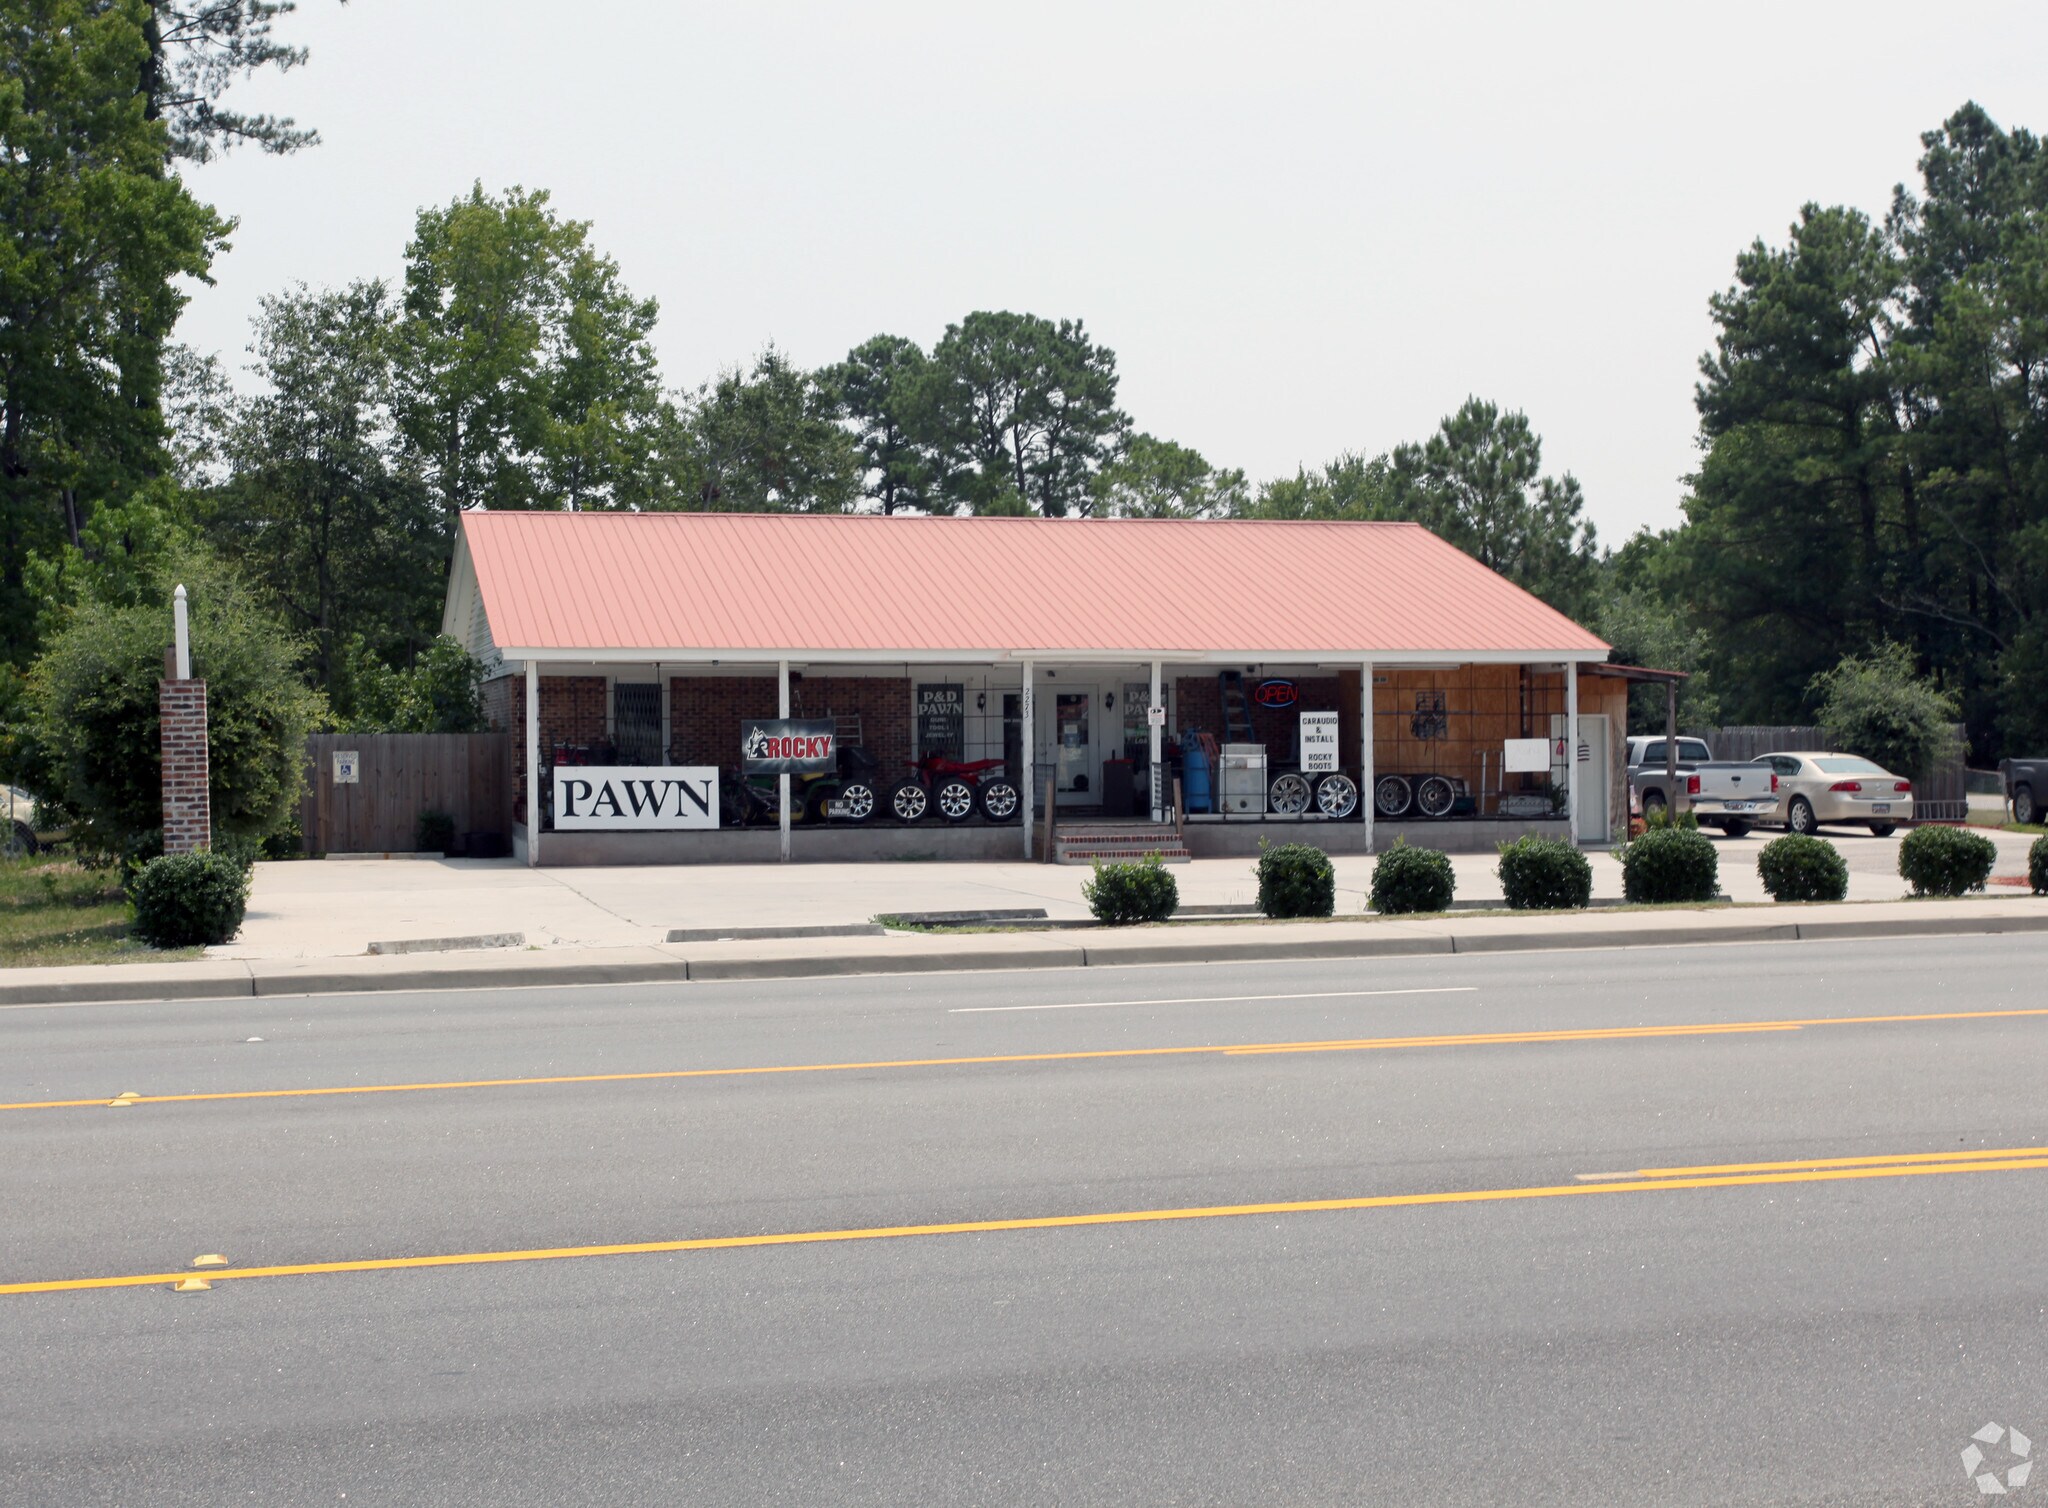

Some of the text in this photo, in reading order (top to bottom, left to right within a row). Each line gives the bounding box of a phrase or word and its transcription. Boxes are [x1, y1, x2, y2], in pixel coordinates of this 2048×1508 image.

[923, 691, 957, 703] P&D
[1255, 686, 1298, 702] OPEN
[918, 703, 963, 715] PAWN
[1302, 717, 1338, 725] CARAUDIO
[1316, 726, 1322, 734] &
[1304, 735, 1334, 743] INSTALL
[767, 735, 833, 759] ROCKY
[1308, 753, 1333, 761] ROCKY
[1308, 762, 1332, 770] BOOTS
[560, 780, 713, 818] PAWN
[828, 808, 850, 816] PARKING
